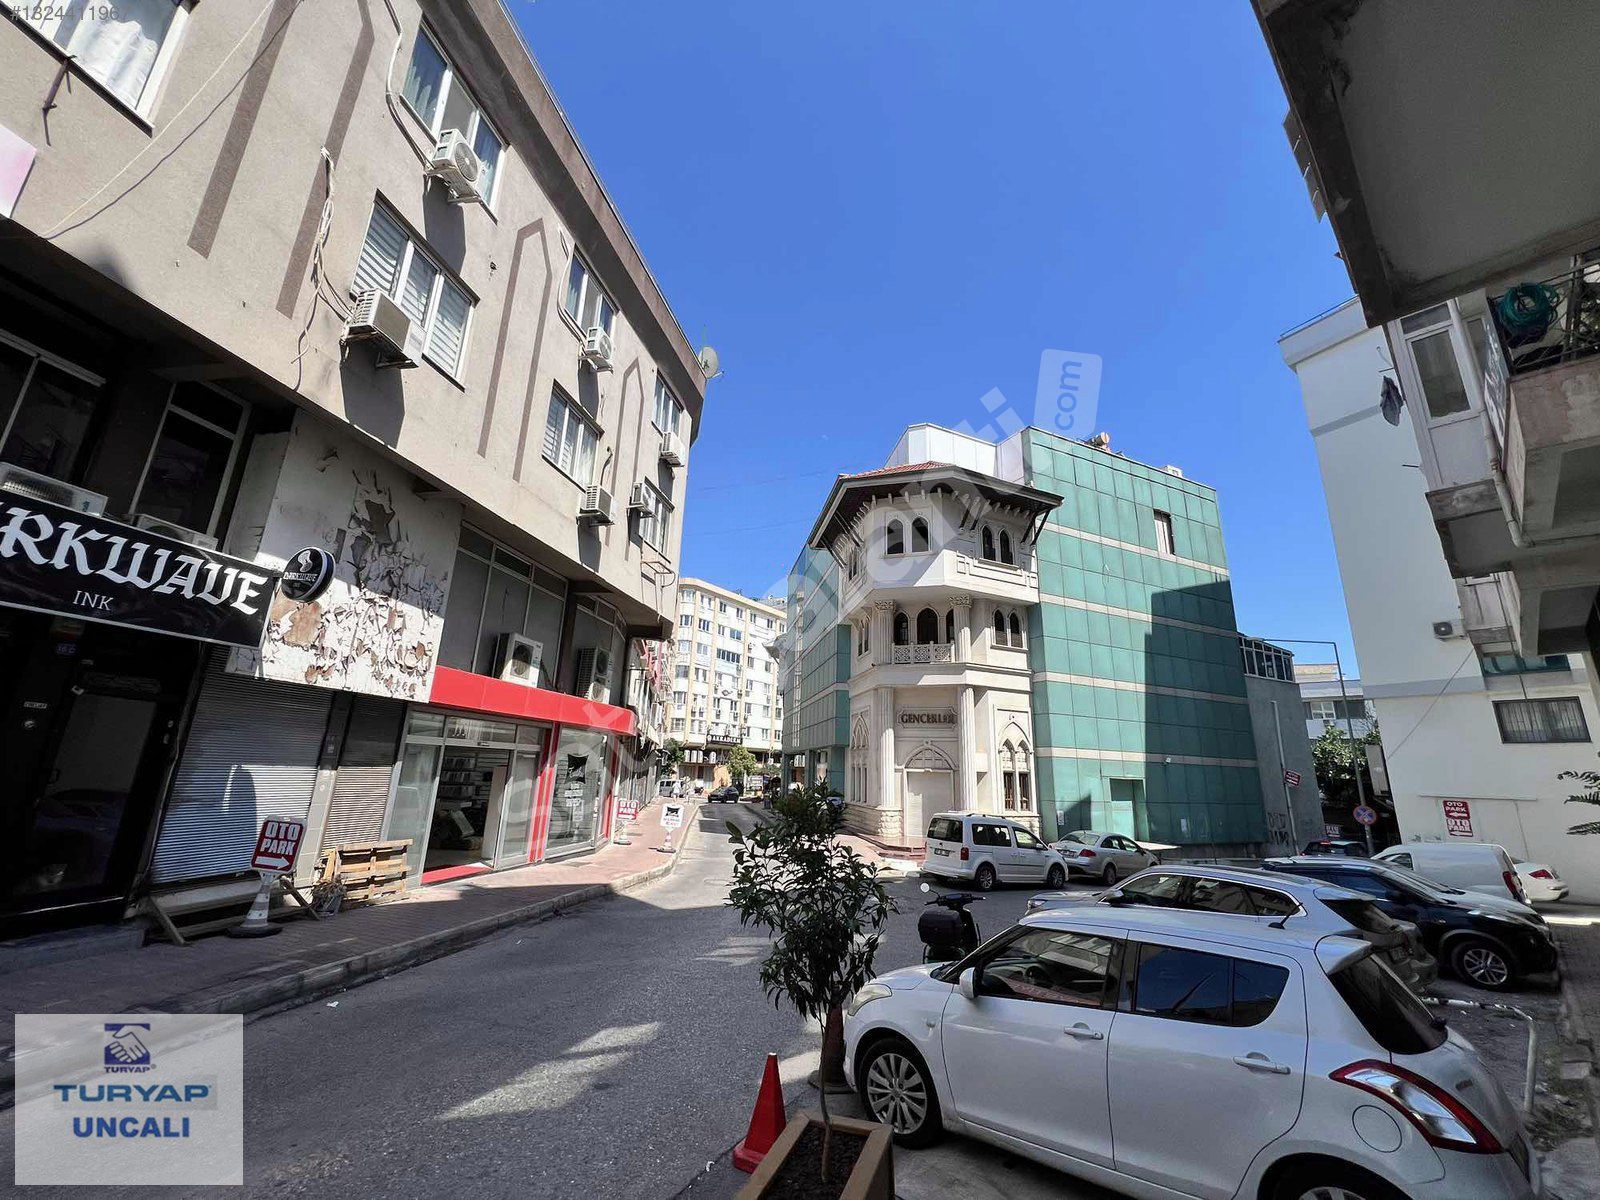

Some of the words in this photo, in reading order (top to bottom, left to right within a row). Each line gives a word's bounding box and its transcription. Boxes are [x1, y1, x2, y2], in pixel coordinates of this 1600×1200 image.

[73, 590, 113, 610] INK
[264, 821, 301, 841] OTO
[260, 838, 296, 856] PARK
